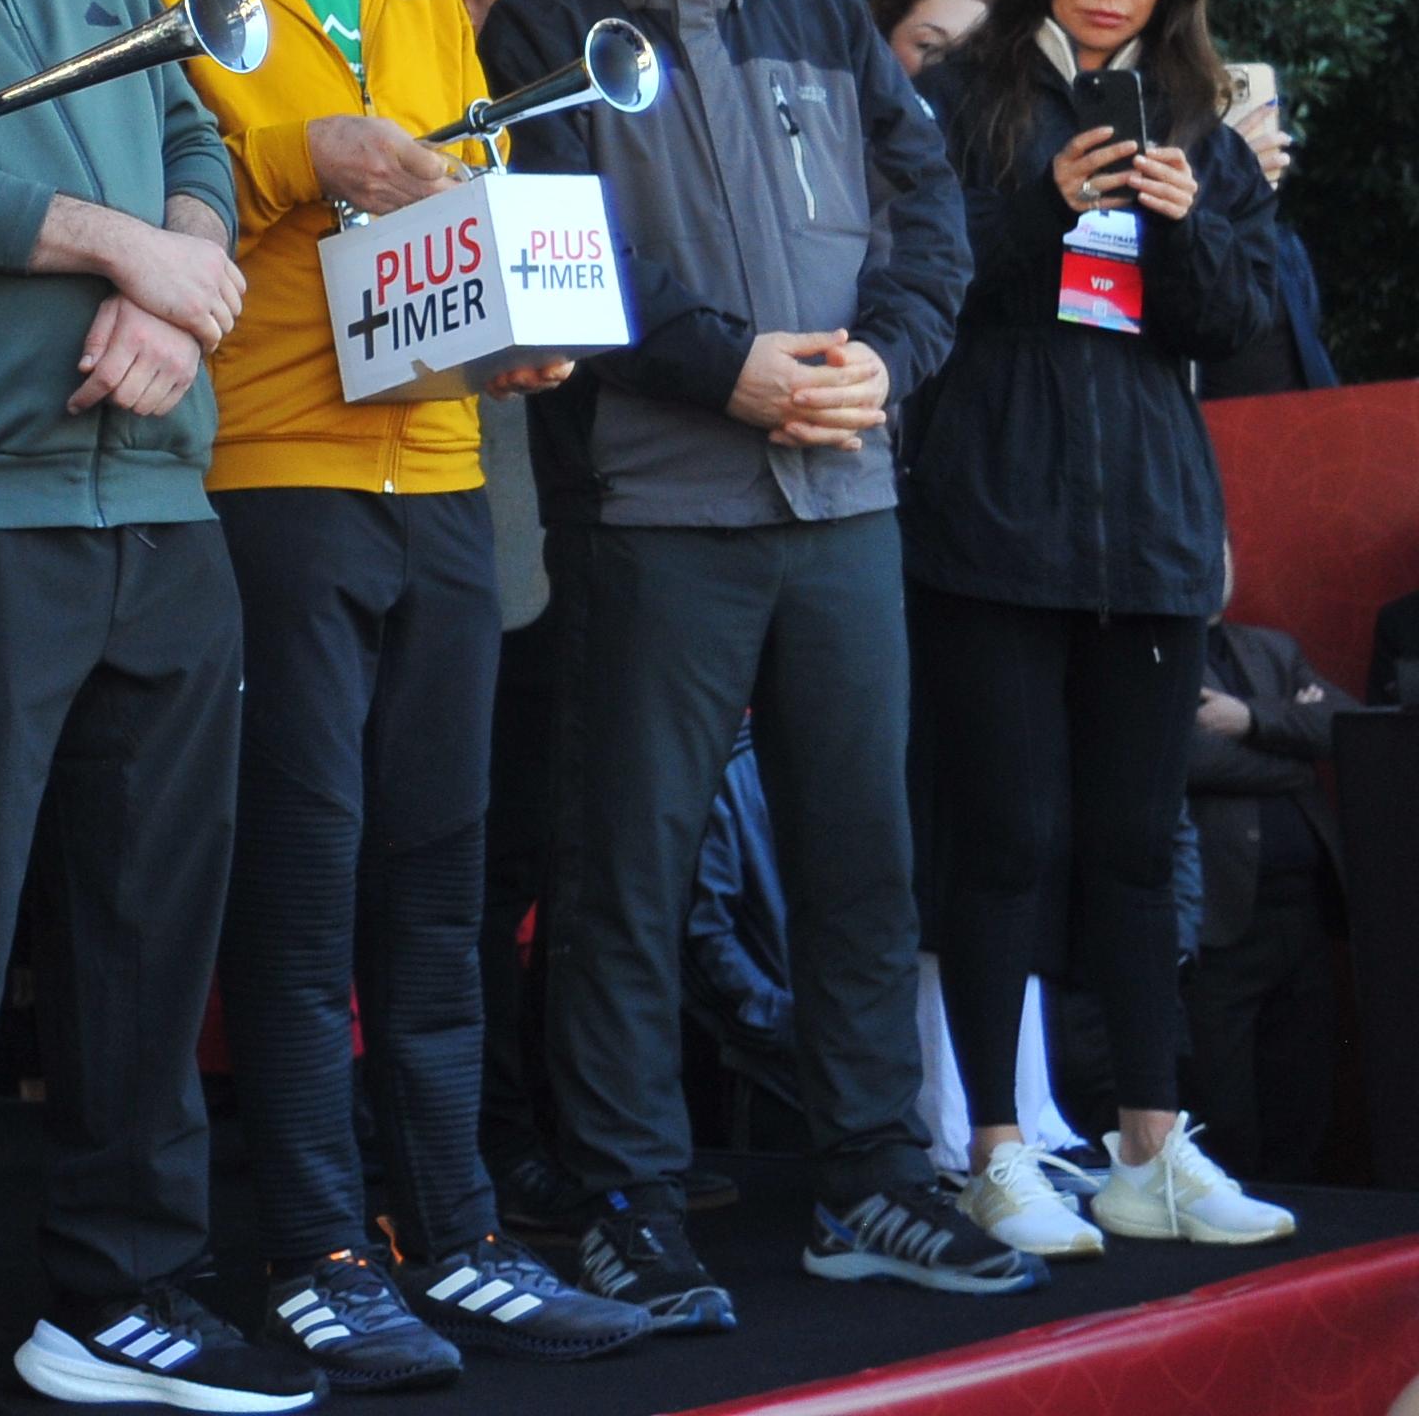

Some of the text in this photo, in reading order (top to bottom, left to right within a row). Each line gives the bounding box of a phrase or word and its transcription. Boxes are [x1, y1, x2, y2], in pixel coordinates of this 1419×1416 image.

[530, 230, 603, 260] PLUS
[377, 217, 481, 306] PLUS
[1090, 275, 1115, 292] VIP
